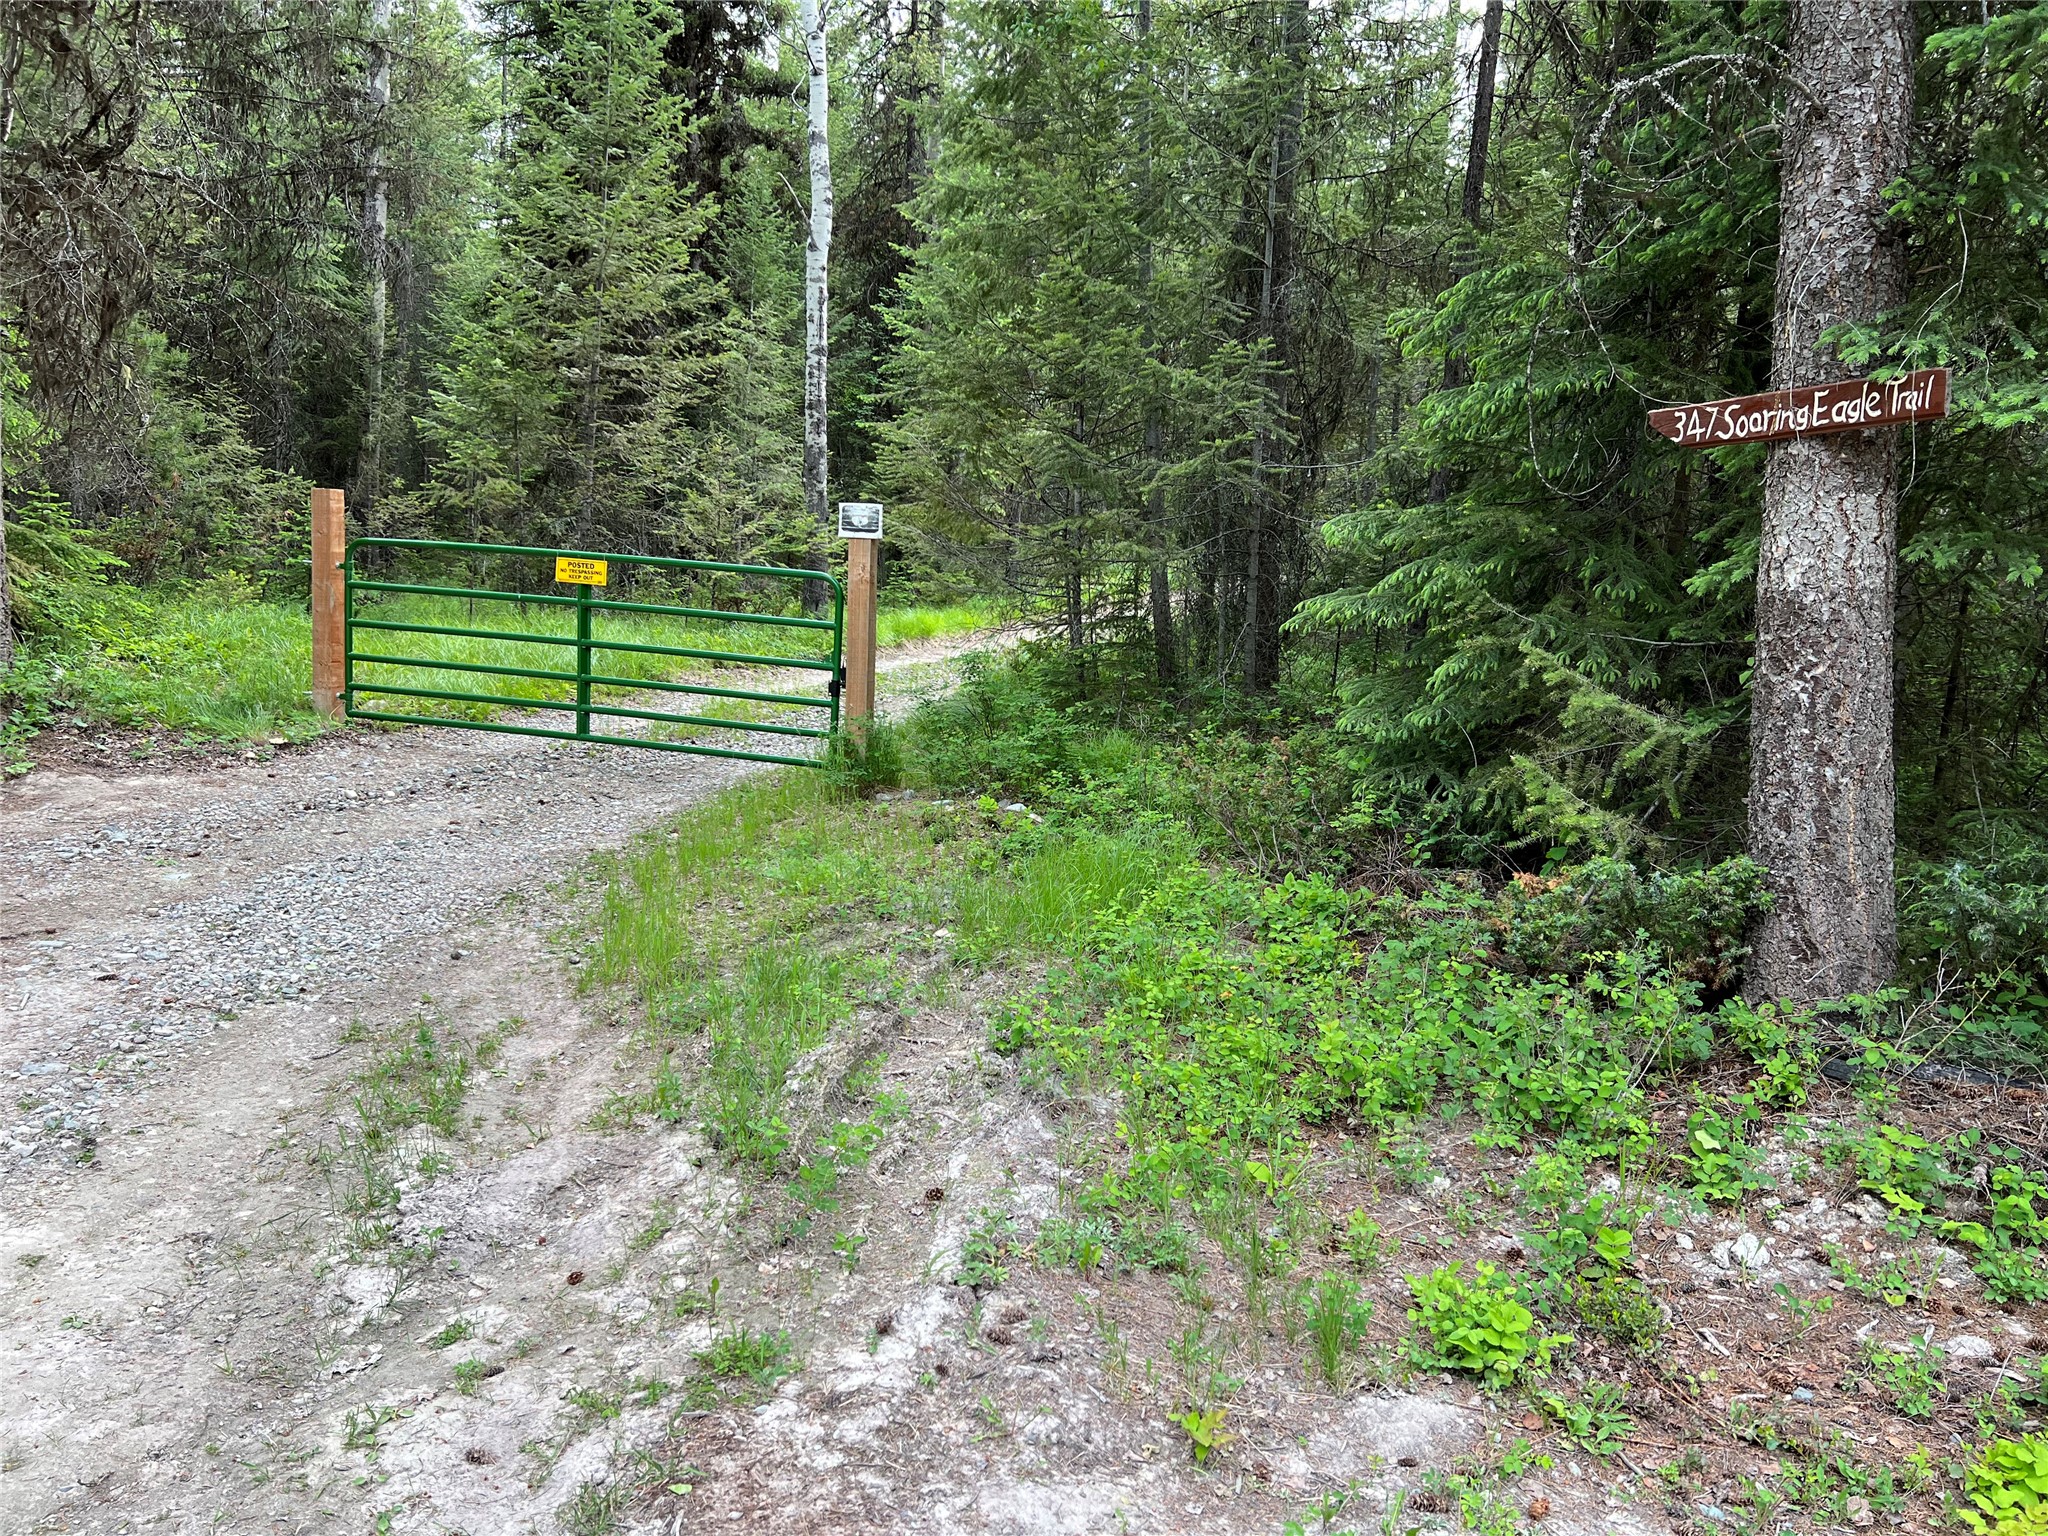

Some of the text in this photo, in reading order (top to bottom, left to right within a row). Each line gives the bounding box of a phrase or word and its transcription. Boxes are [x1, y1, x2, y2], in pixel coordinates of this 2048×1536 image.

[1670, 374, 1936, 442] 347 Soaring Eagle Trail
